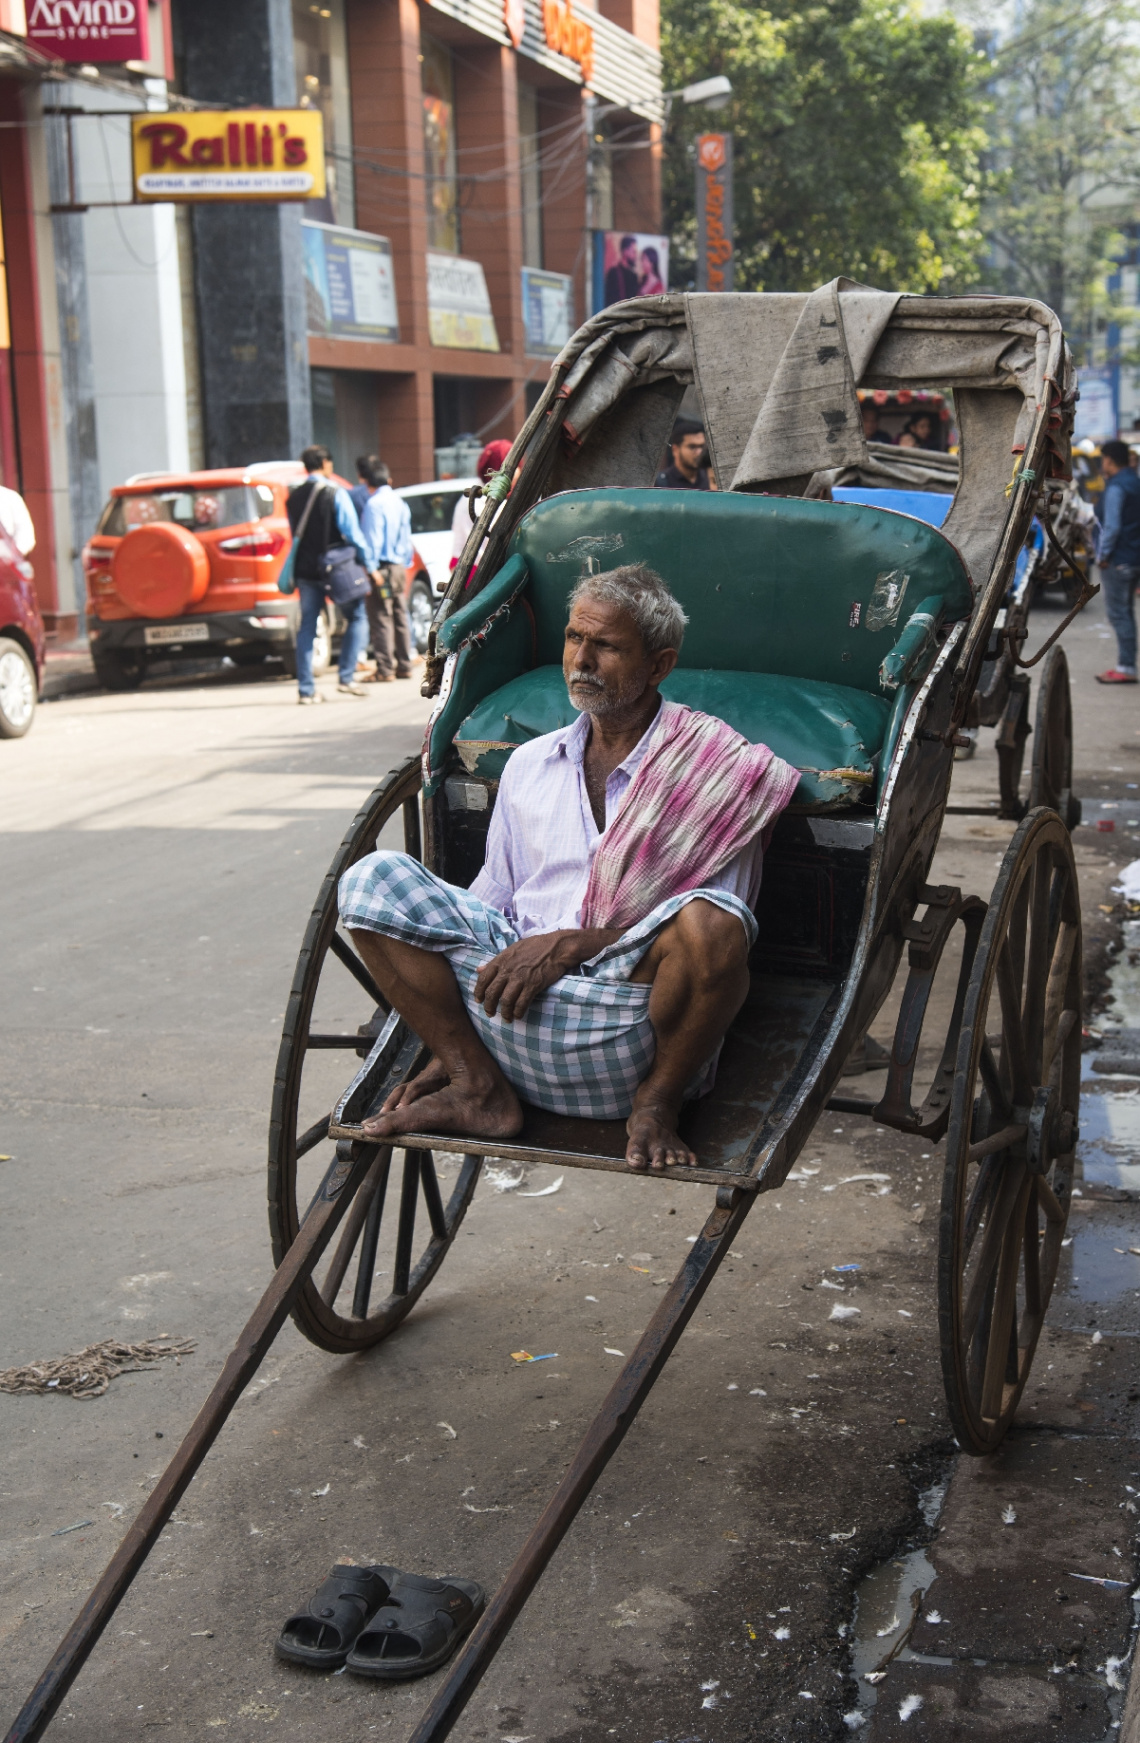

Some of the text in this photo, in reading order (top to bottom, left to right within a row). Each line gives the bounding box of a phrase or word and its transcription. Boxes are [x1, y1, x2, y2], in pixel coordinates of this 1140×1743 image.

[57, 25, 109, 40] STORE
[140, 121, 308, 168] Ralli's
[853, 603, 861, 624] FIRE
